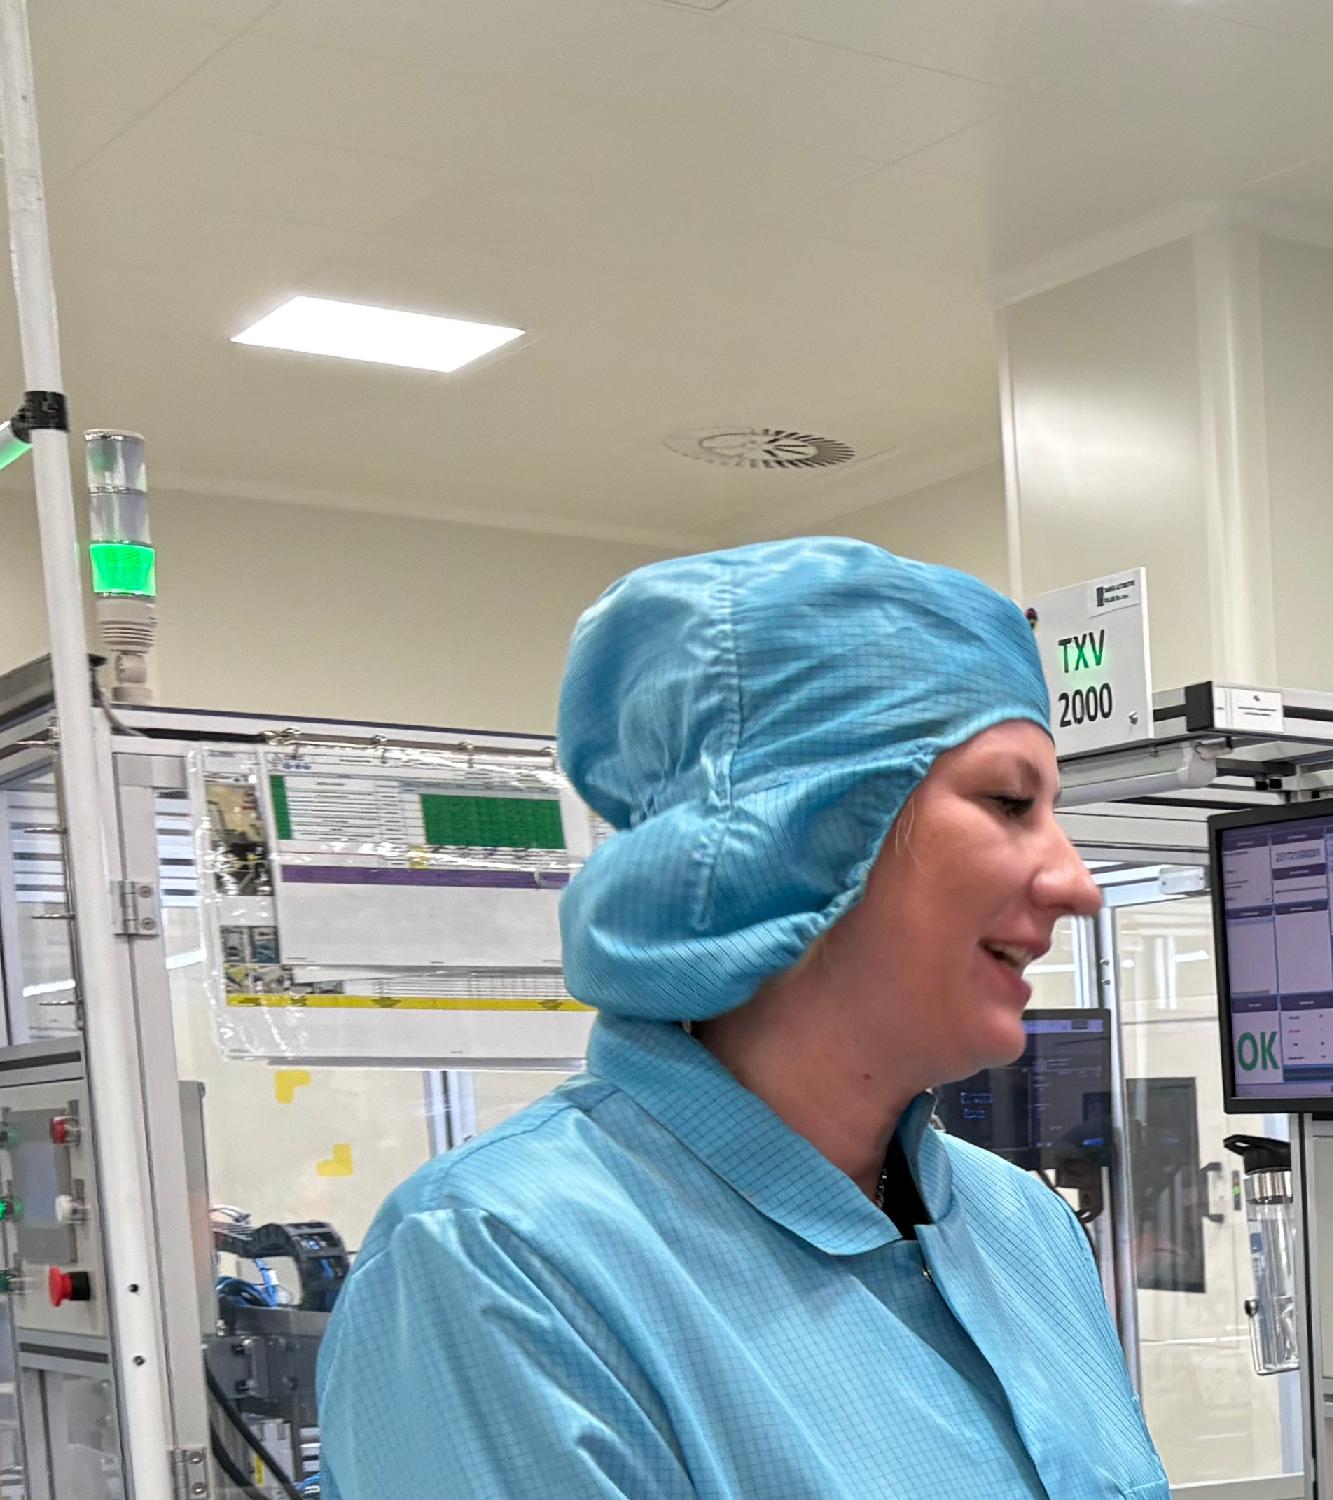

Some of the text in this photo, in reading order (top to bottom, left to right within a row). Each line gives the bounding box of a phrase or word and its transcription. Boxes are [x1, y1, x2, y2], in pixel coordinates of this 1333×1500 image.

[1058, 629, 1105, 673] TXV
[1058, 682, 1113, 728] 2000
[1237, 1031, 1280, 1071] OK
